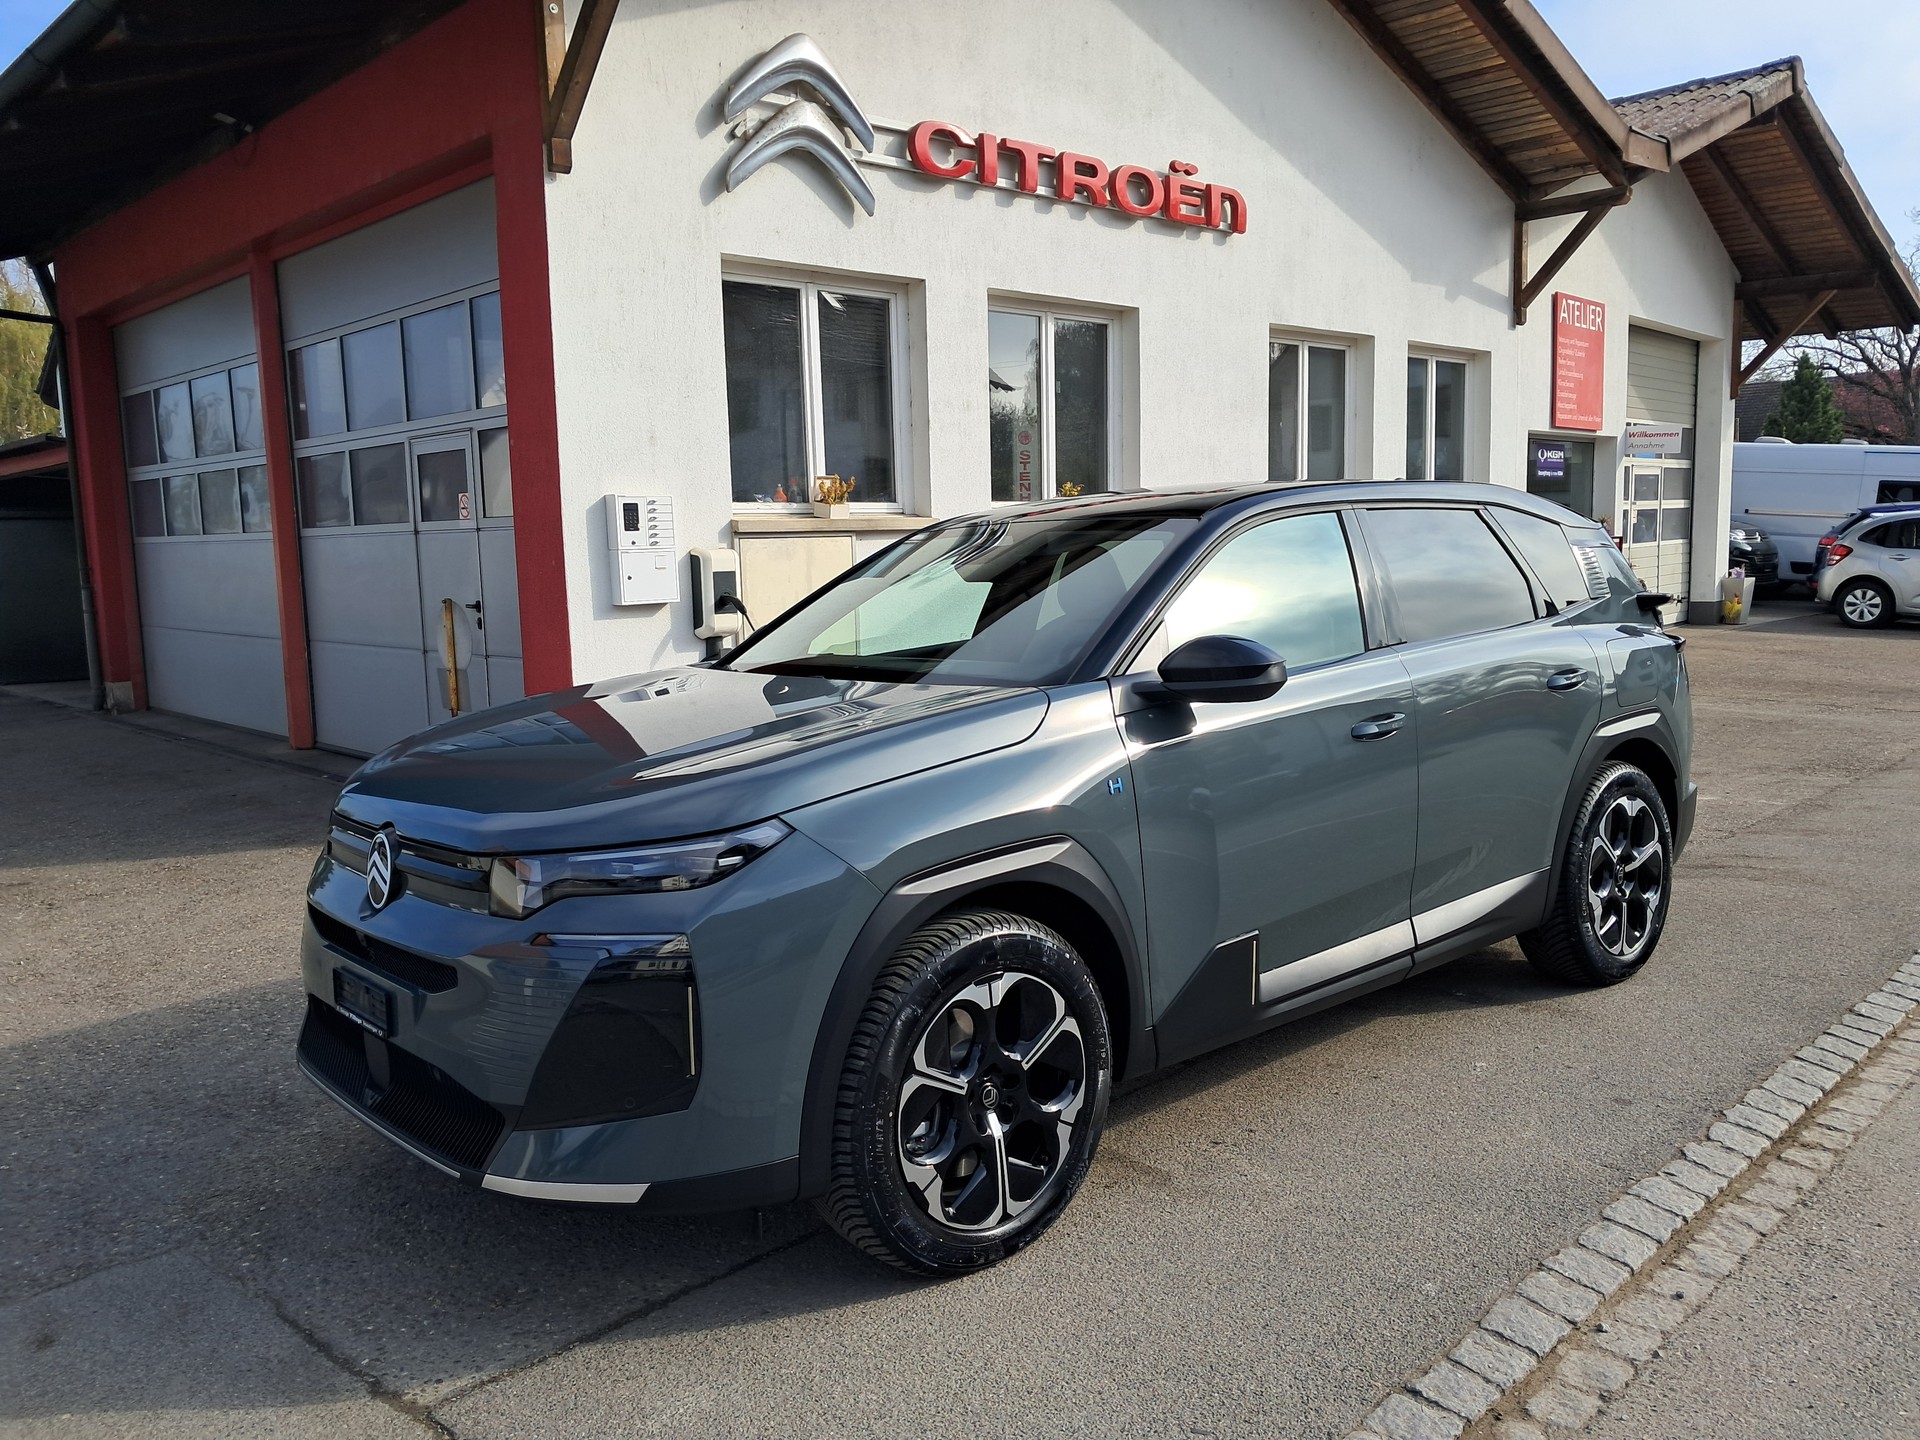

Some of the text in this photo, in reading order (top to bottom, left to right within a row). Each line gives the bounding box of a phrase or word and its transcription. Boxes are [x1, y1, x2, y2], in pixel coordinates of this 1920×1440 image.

[1559, 298, 1603, 332] ATELIER
[1628, 430, 1680, 438] Willkommen
[1627, 441, 1665, 449] Annahme
[1547, 450, 1564, 459] KGM
